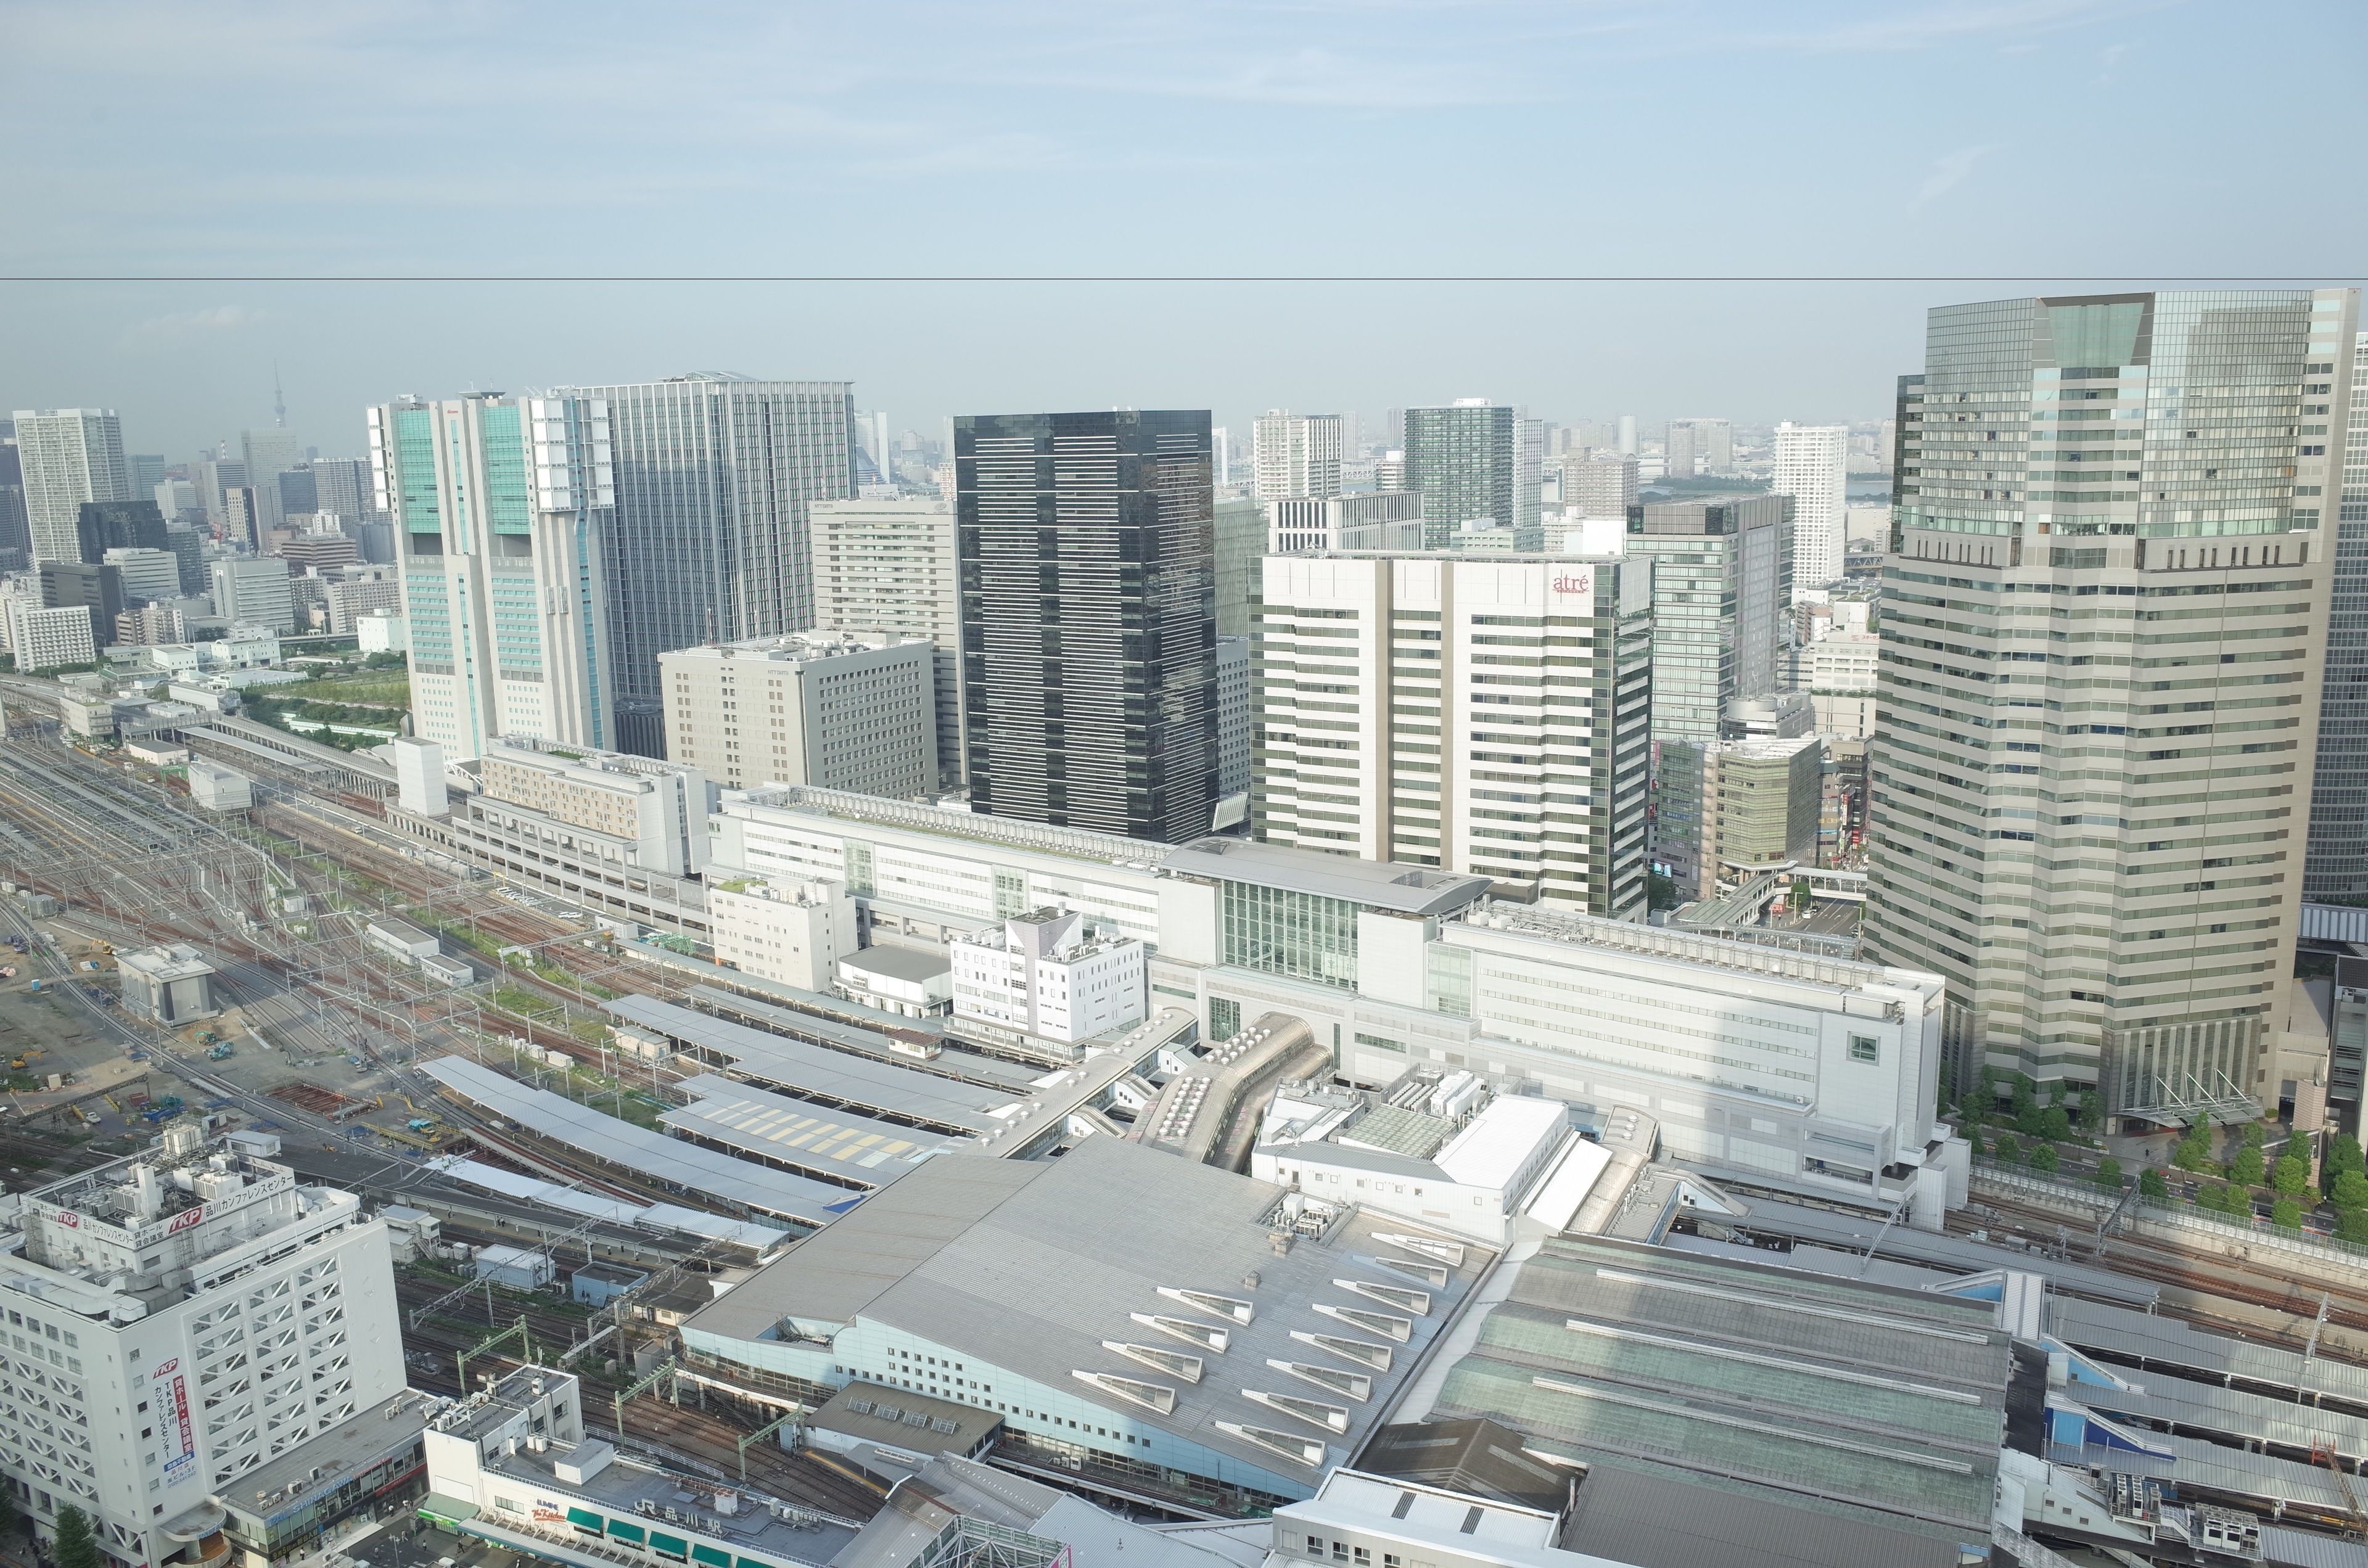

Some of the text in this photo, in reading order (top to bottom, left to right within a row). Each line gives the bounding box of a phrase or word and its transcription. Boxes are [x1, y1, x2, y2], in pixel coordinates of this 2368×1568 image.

[1553, 574, 1589, 591] atré
[205, 1176, 293, 1218] 品川カンファレンスセンター
[39, 1203, 57, 1214] 貸ホール
[59, 1212, 78, 1226] TKP
[171, 1208, 200, 1232] TKP
[83, 1218, 133, 1244] 品川カンファレンスセンター
[134, 1223, 163, 1240] 貸ホール
[135, 1231, 164, 1248] 貸会議室
[155, 1359, 177, 1377] TKP
[154, 1386, 169, 1458] カンファレンスセンター
[293, 1475, 354, 1513] SHINAGAWA
[635, 1498, 723, 1534] JR 品川駅
